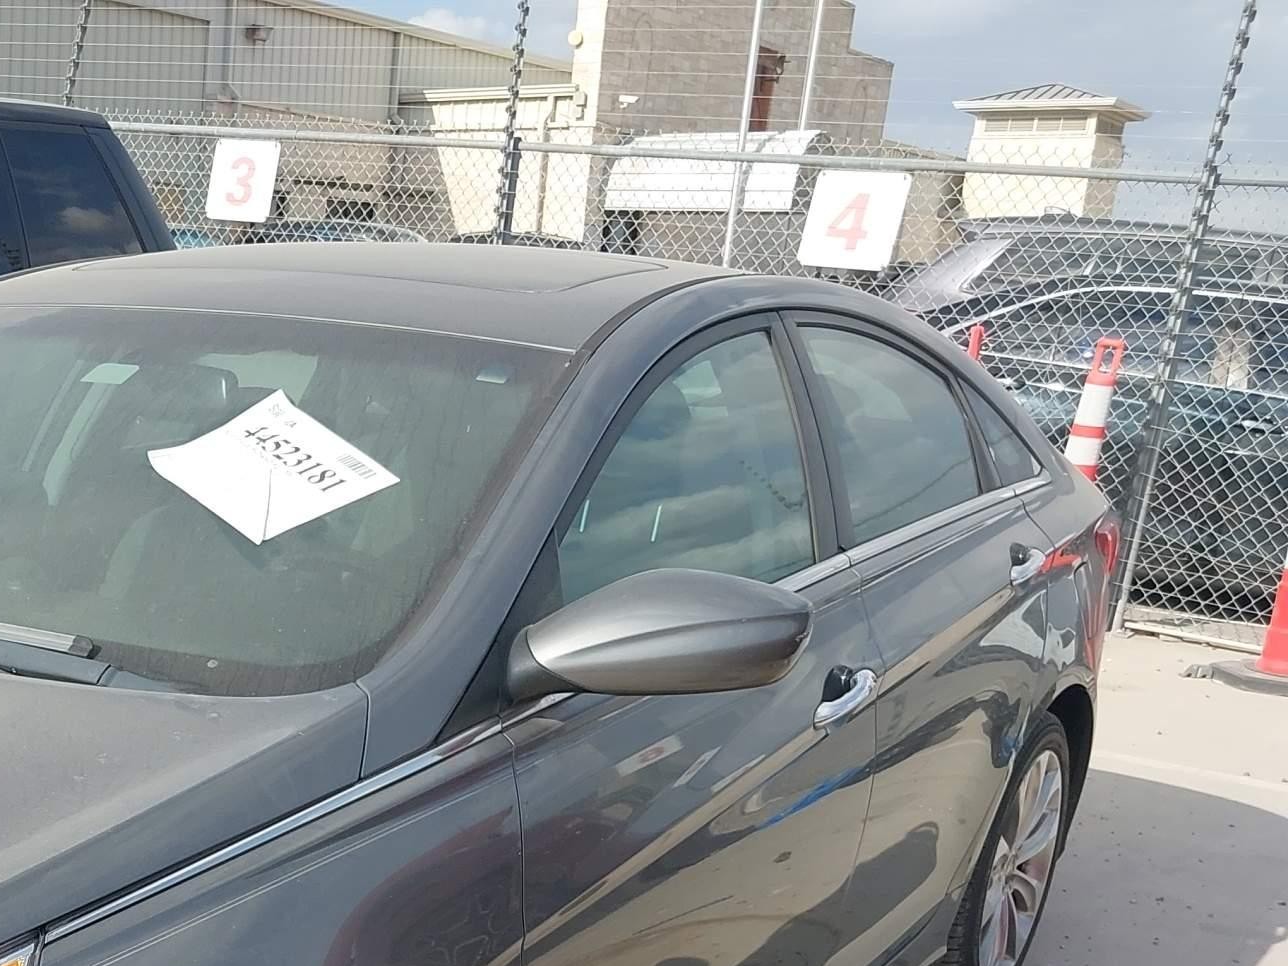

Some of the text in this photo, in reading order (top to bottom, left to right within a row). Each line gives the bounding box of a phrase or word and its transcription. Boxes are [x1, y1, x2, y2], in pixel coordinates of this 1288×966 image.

[225, 156, 257, 206] 3
[825, 192, 871, 251] 4
[243, 426, 348, 493] 44523181
